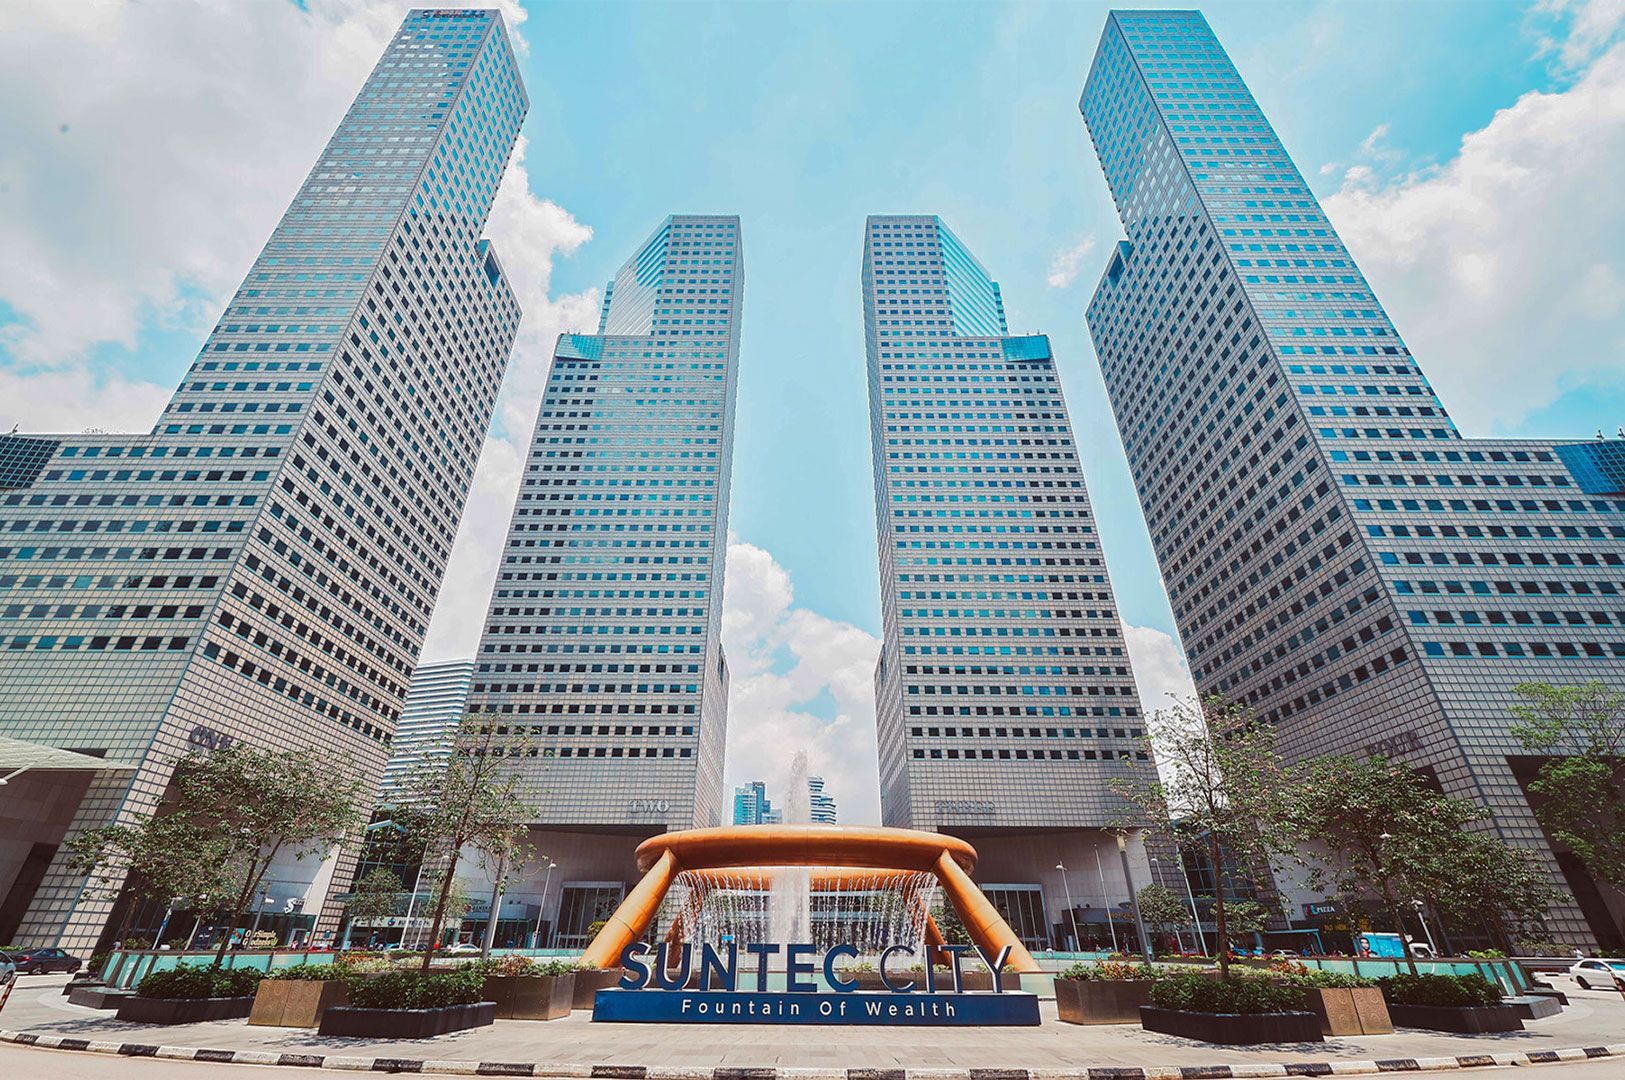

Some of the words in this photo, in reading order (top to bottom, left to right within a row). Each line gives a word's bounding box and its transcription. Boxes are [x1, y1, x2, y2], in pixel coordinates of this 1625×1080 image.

[629, 799, 670, 813] TWO
[935, 800, 996, 815] THREE
[619, 942, 860, 993] SUNTEC
[879, 944, 1012, 994] CITY
[682, 999, 799, 1015] Fountain
[819, 1000, 846, 1015] Of
[865, 1001, 956, 1017] Wealth
